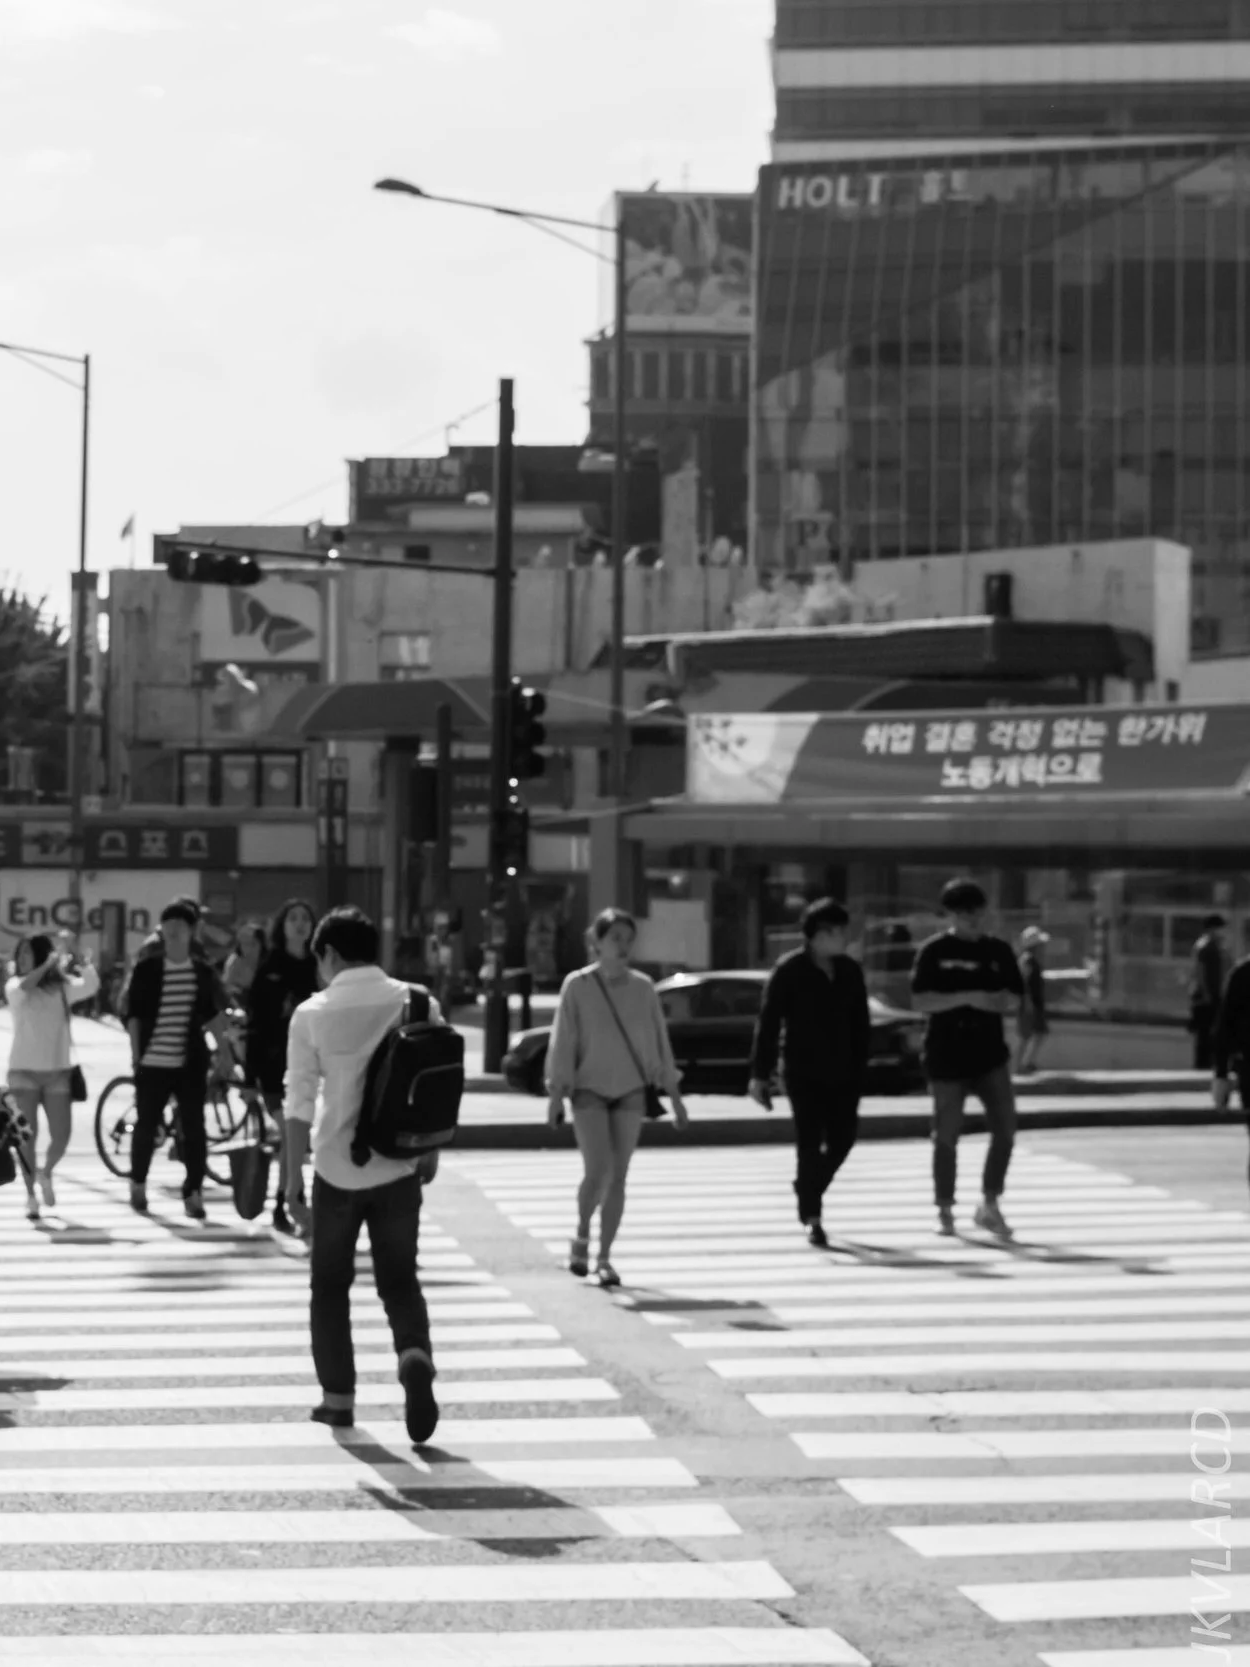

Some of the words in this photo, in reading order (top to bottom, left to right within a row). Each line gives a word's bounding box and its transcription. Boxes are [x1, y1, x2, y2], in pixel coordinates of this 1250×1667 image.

[777, 172, 889, 209] HOLT
[862, 721, 915, 754] 취업
[987, 718, 1044, 751] 걱정
[1052, 716, 1108, 748] 없는
[1117, 712, 1208, 746] 한가위
[940, 751, 1103, 790] 노동개혁으로
